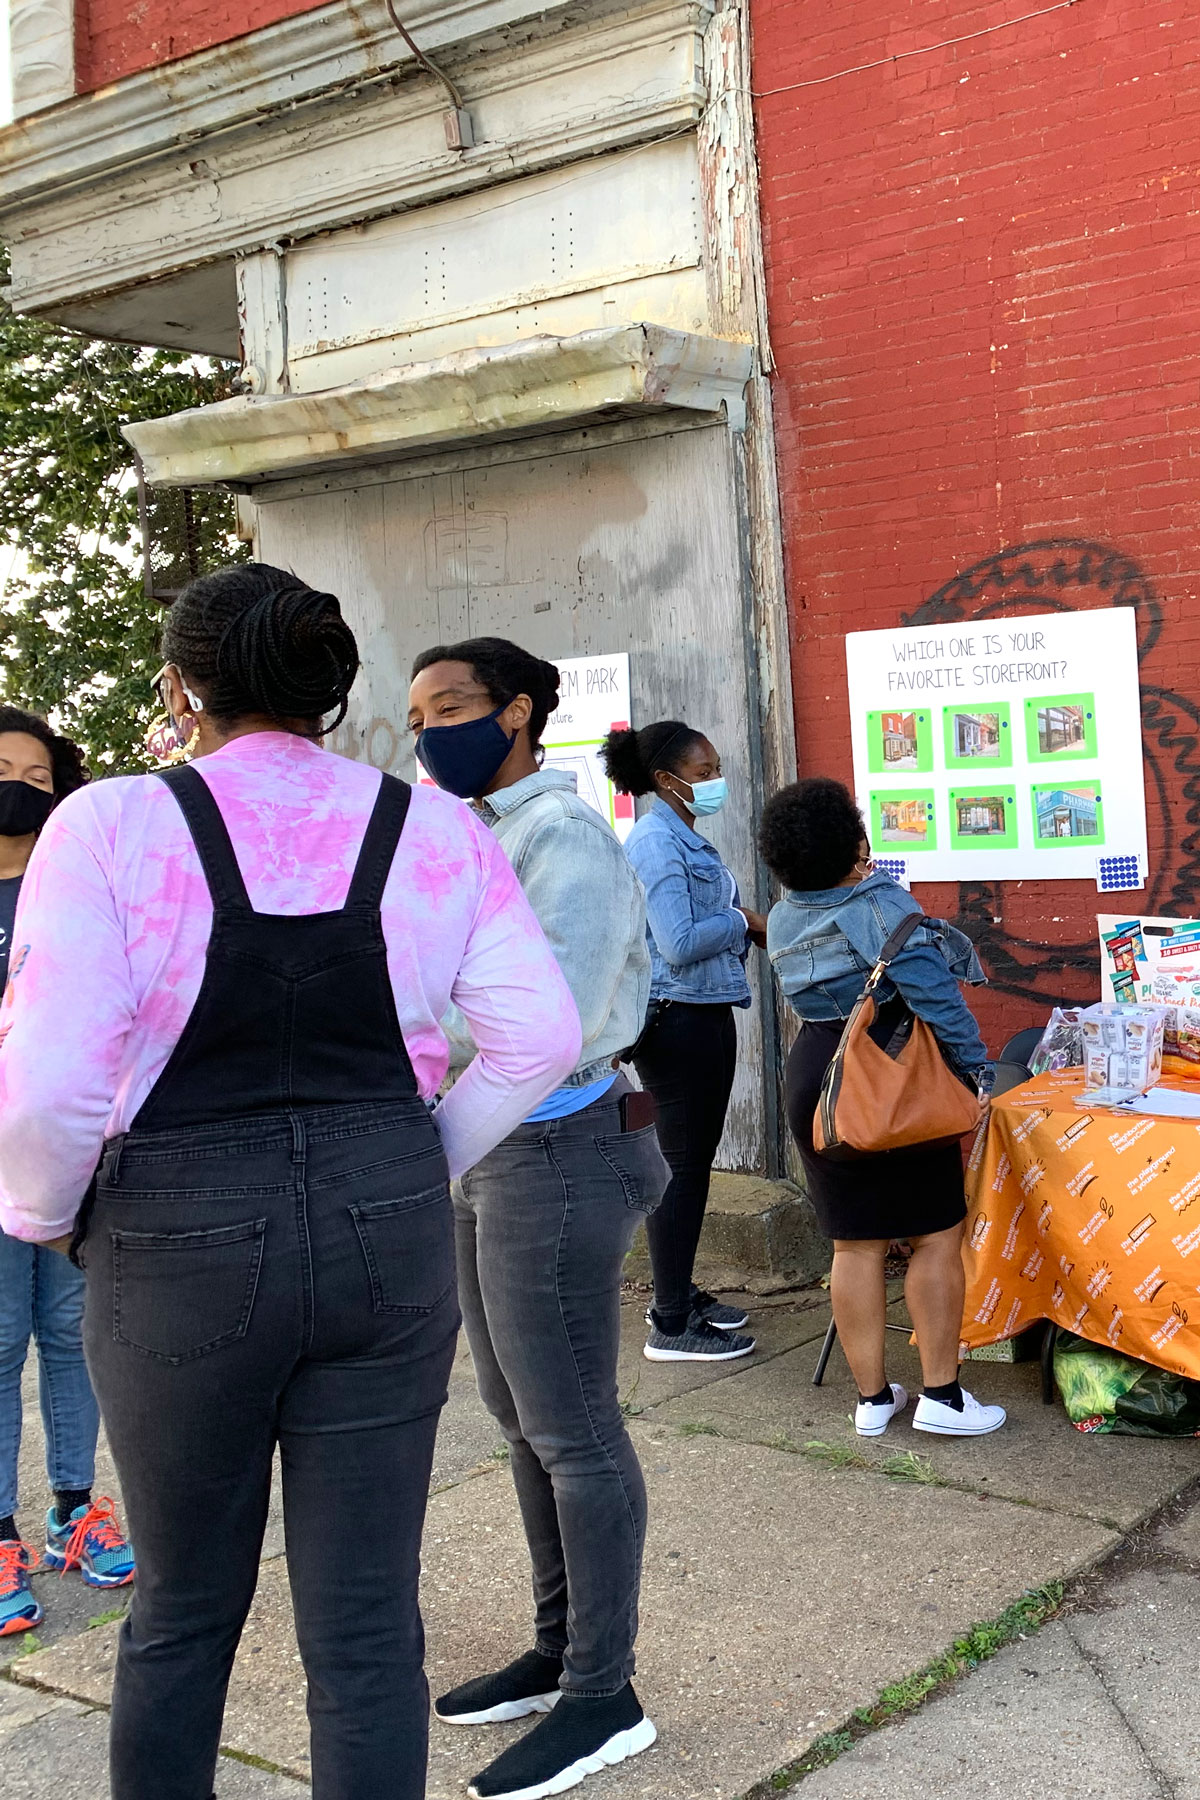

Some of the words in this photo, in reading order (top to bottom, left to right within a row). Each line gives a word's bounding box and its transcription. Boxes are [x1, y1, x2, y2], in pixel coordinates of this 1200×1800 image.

[893, 640, 945, 662] WHICH
[950, 638, 976, 657] ONE
[982, 635, 1002, 655] IS
[1008, 632, 1046, 651] YOUR
[587, 667, 619, 694] PARK
[888, 668, 965, 691] FAVORITE
[973, 661, 1067, 686] STOREFRONT?
[1127, 1178, 1138, 1188] the
[1139, 1146, 1175, 1178] playground
[1169, 1193, 1181, 1204] the
[1173, 1200, 1185, 1211] are
[974, 1309, 984, 1322] the
[982, 1277, 998, 1308] schools
[981, 1311, 990, 1324] are
